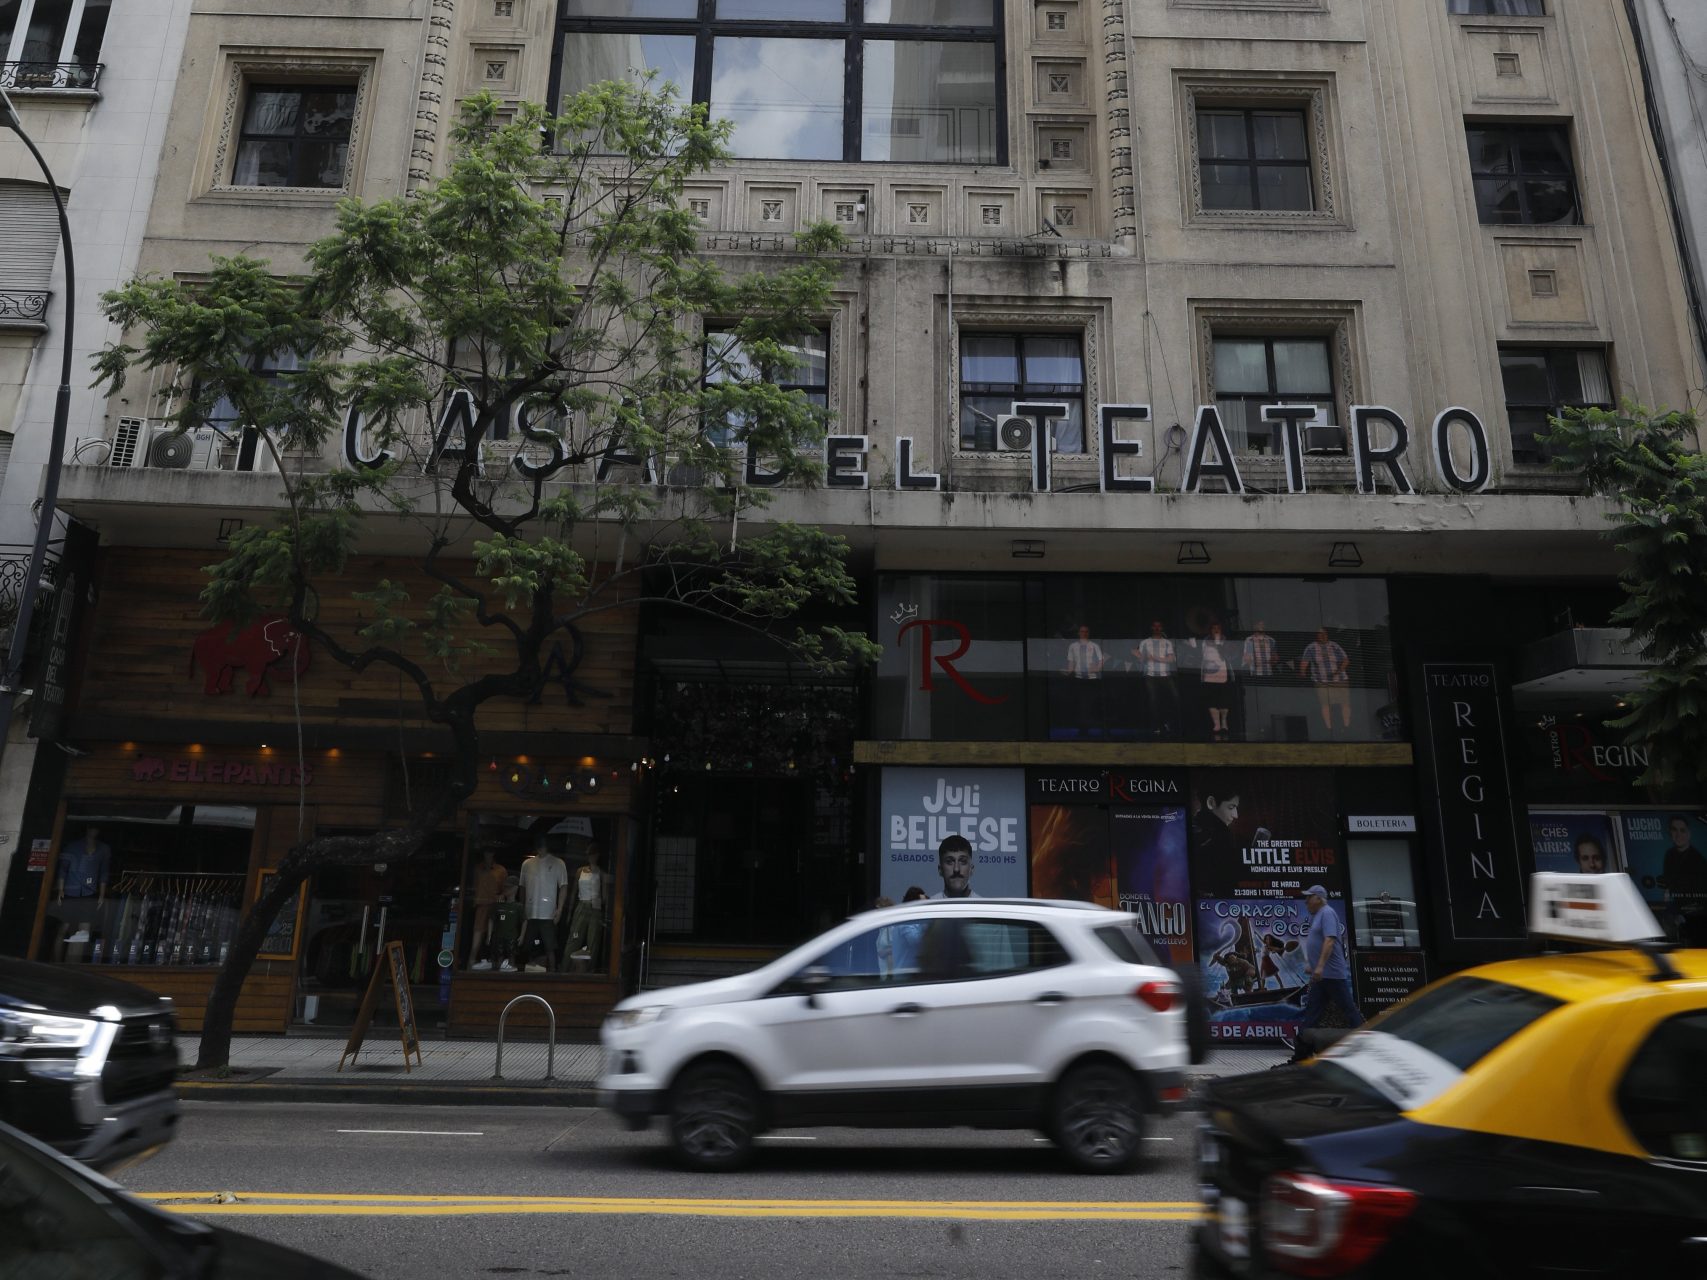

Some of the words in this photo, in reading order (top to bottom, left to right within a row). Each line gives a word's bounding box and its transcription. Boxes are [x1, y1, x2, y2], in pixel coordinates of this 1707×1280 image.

[342, 388, 658, 487] CASA
[1011, 401, 1491, 496] TEATRO
[50, 646, 66, 665] CASA
[46, 664, 57, 684] DEL
[1431, 674, 1490, 687] TEATRO
[44, 683, 65, 704] TEATRO
[1551, 730, 1562, 769] TEATRO
[169, 758, 314, 786] ELEPANTS
[1039, 778, 1100, 792] TEATRO
[1106, 773, 1178, 801] REGINA
[1453, 701, 1501, 920] REGINA
[890, 814, 1018, 852] BELLESE
[1627, 818, 1661, 831] LUCHO
[1630, 831, 1663, 840] MIRANDA
[978, 854, 1002, 864] 23:00
[1003, 855, 1017, 864] HS
[1242, 848, 1290, 864] LITTLE
[1295, 849, 1335, 864] ELVIS
[1200, 901, 1211, 910] EL
[1119, 900, 1187, 936] TANGO
[1272, 918, 1346, 937] OCÉO
[1153, 937, 1167, 945] NOS
[1222, 1026, 1242, 1037] DE
[1245, 1026, 1287, 1038] ABRIL
